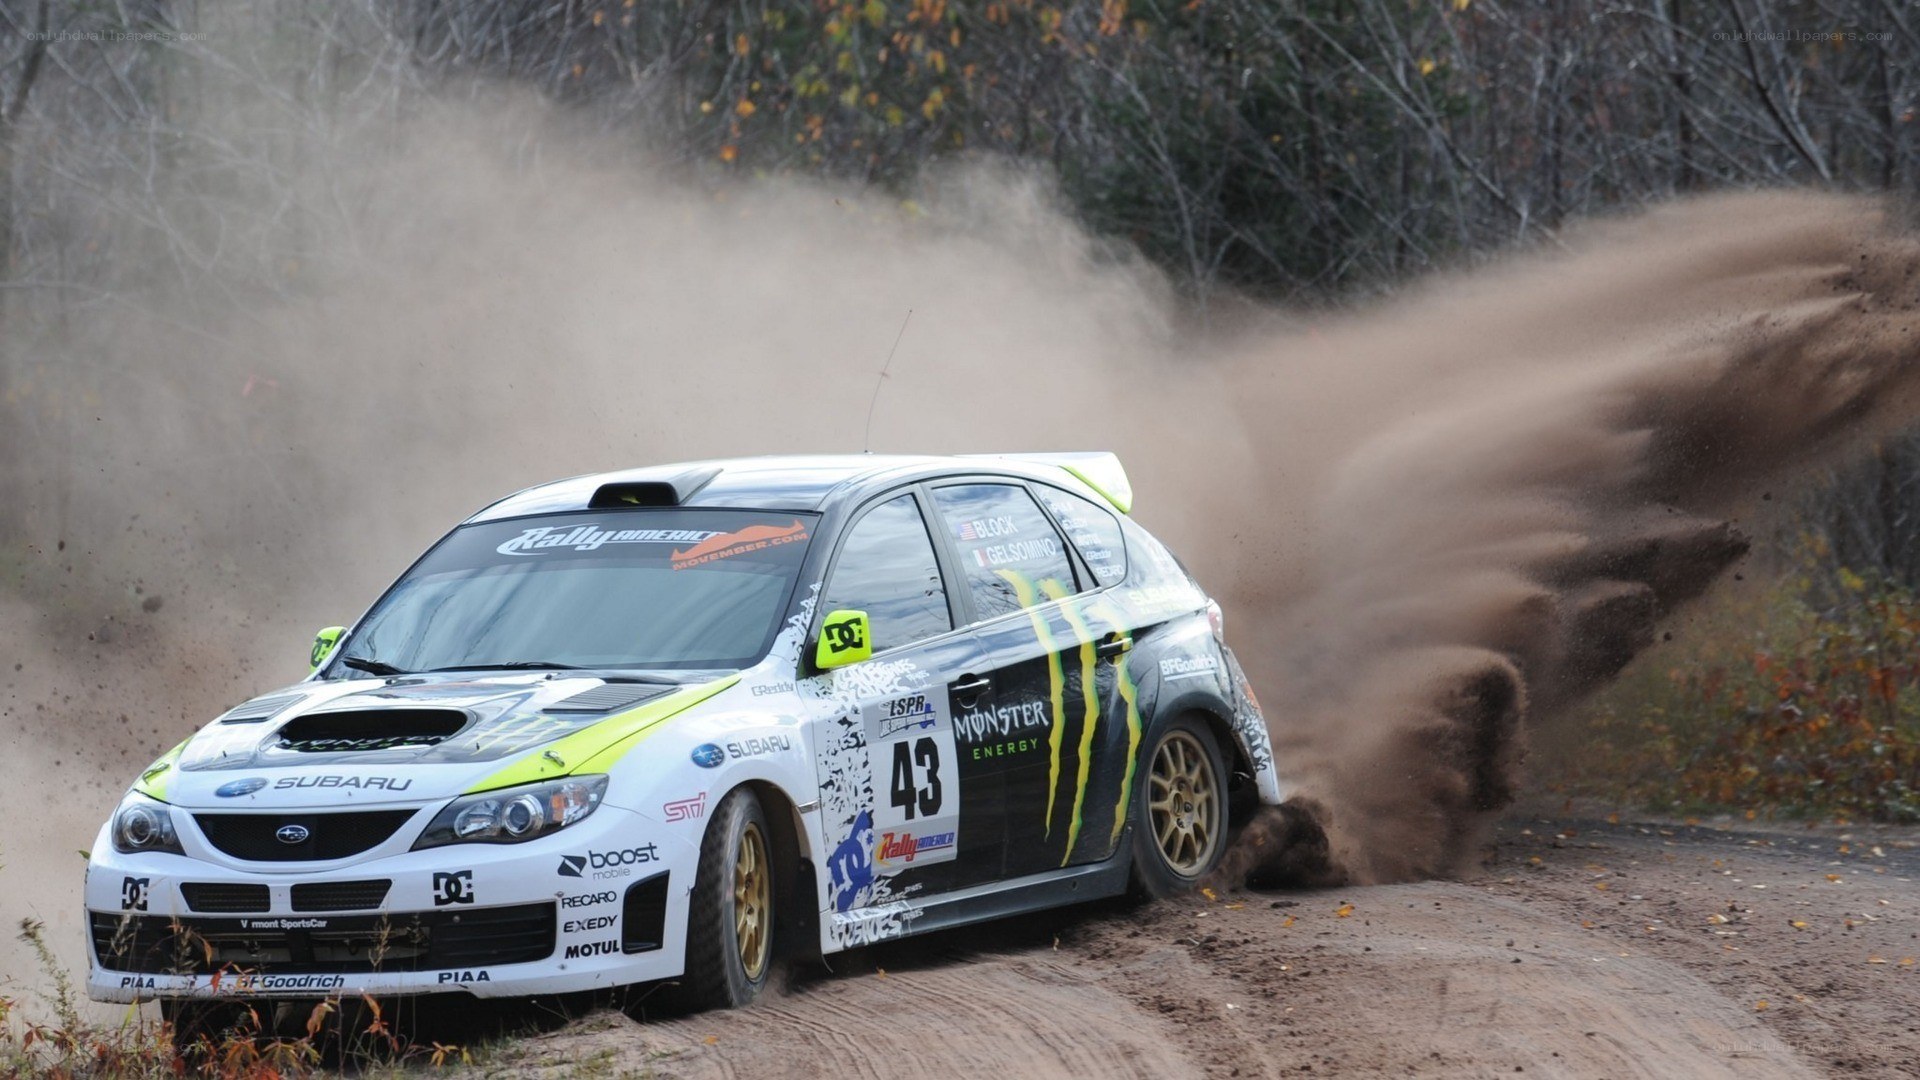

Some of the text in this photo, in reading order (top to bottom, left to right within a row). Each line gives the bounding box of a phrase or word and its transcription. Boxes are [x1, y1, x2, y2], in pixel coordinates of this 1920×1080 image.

[500, 525, 615, 551] Rally
[972, 516, 1018, 539] BLOCK
[673, 532, 808, 571] MOVEMBER.COM
[986, 538, 1056, 565] GELSOMINO
[824, 617, 864, 654] DC
[752, 682, 794, 696] GReddy
[889, 695, 926, 717] LSPR
[953, 701, 1049, 743] MONSTER
[727, 735, 791, 759] SUBARU
[973, 738, 1039, 760] ENERGY
[273, 775, 413, 792] SUBARU
[890, 736, 942, 821] 43
[588, 842, 660, 869] boost
[879, 832, 918, 862] Rally
[593, 867, 631, 880] mobile
[433, 870, 474, 906] DC
[561, 891, 617, 909] RECARO
[280, 918, 328, 930] SportsCar
[563, 915, 618, 933] EXEDY
[565, 940, 620, 959] MOTUL
[120, 976, 155, 989] PIAA
[438, 971, 491, 984] PIAA
